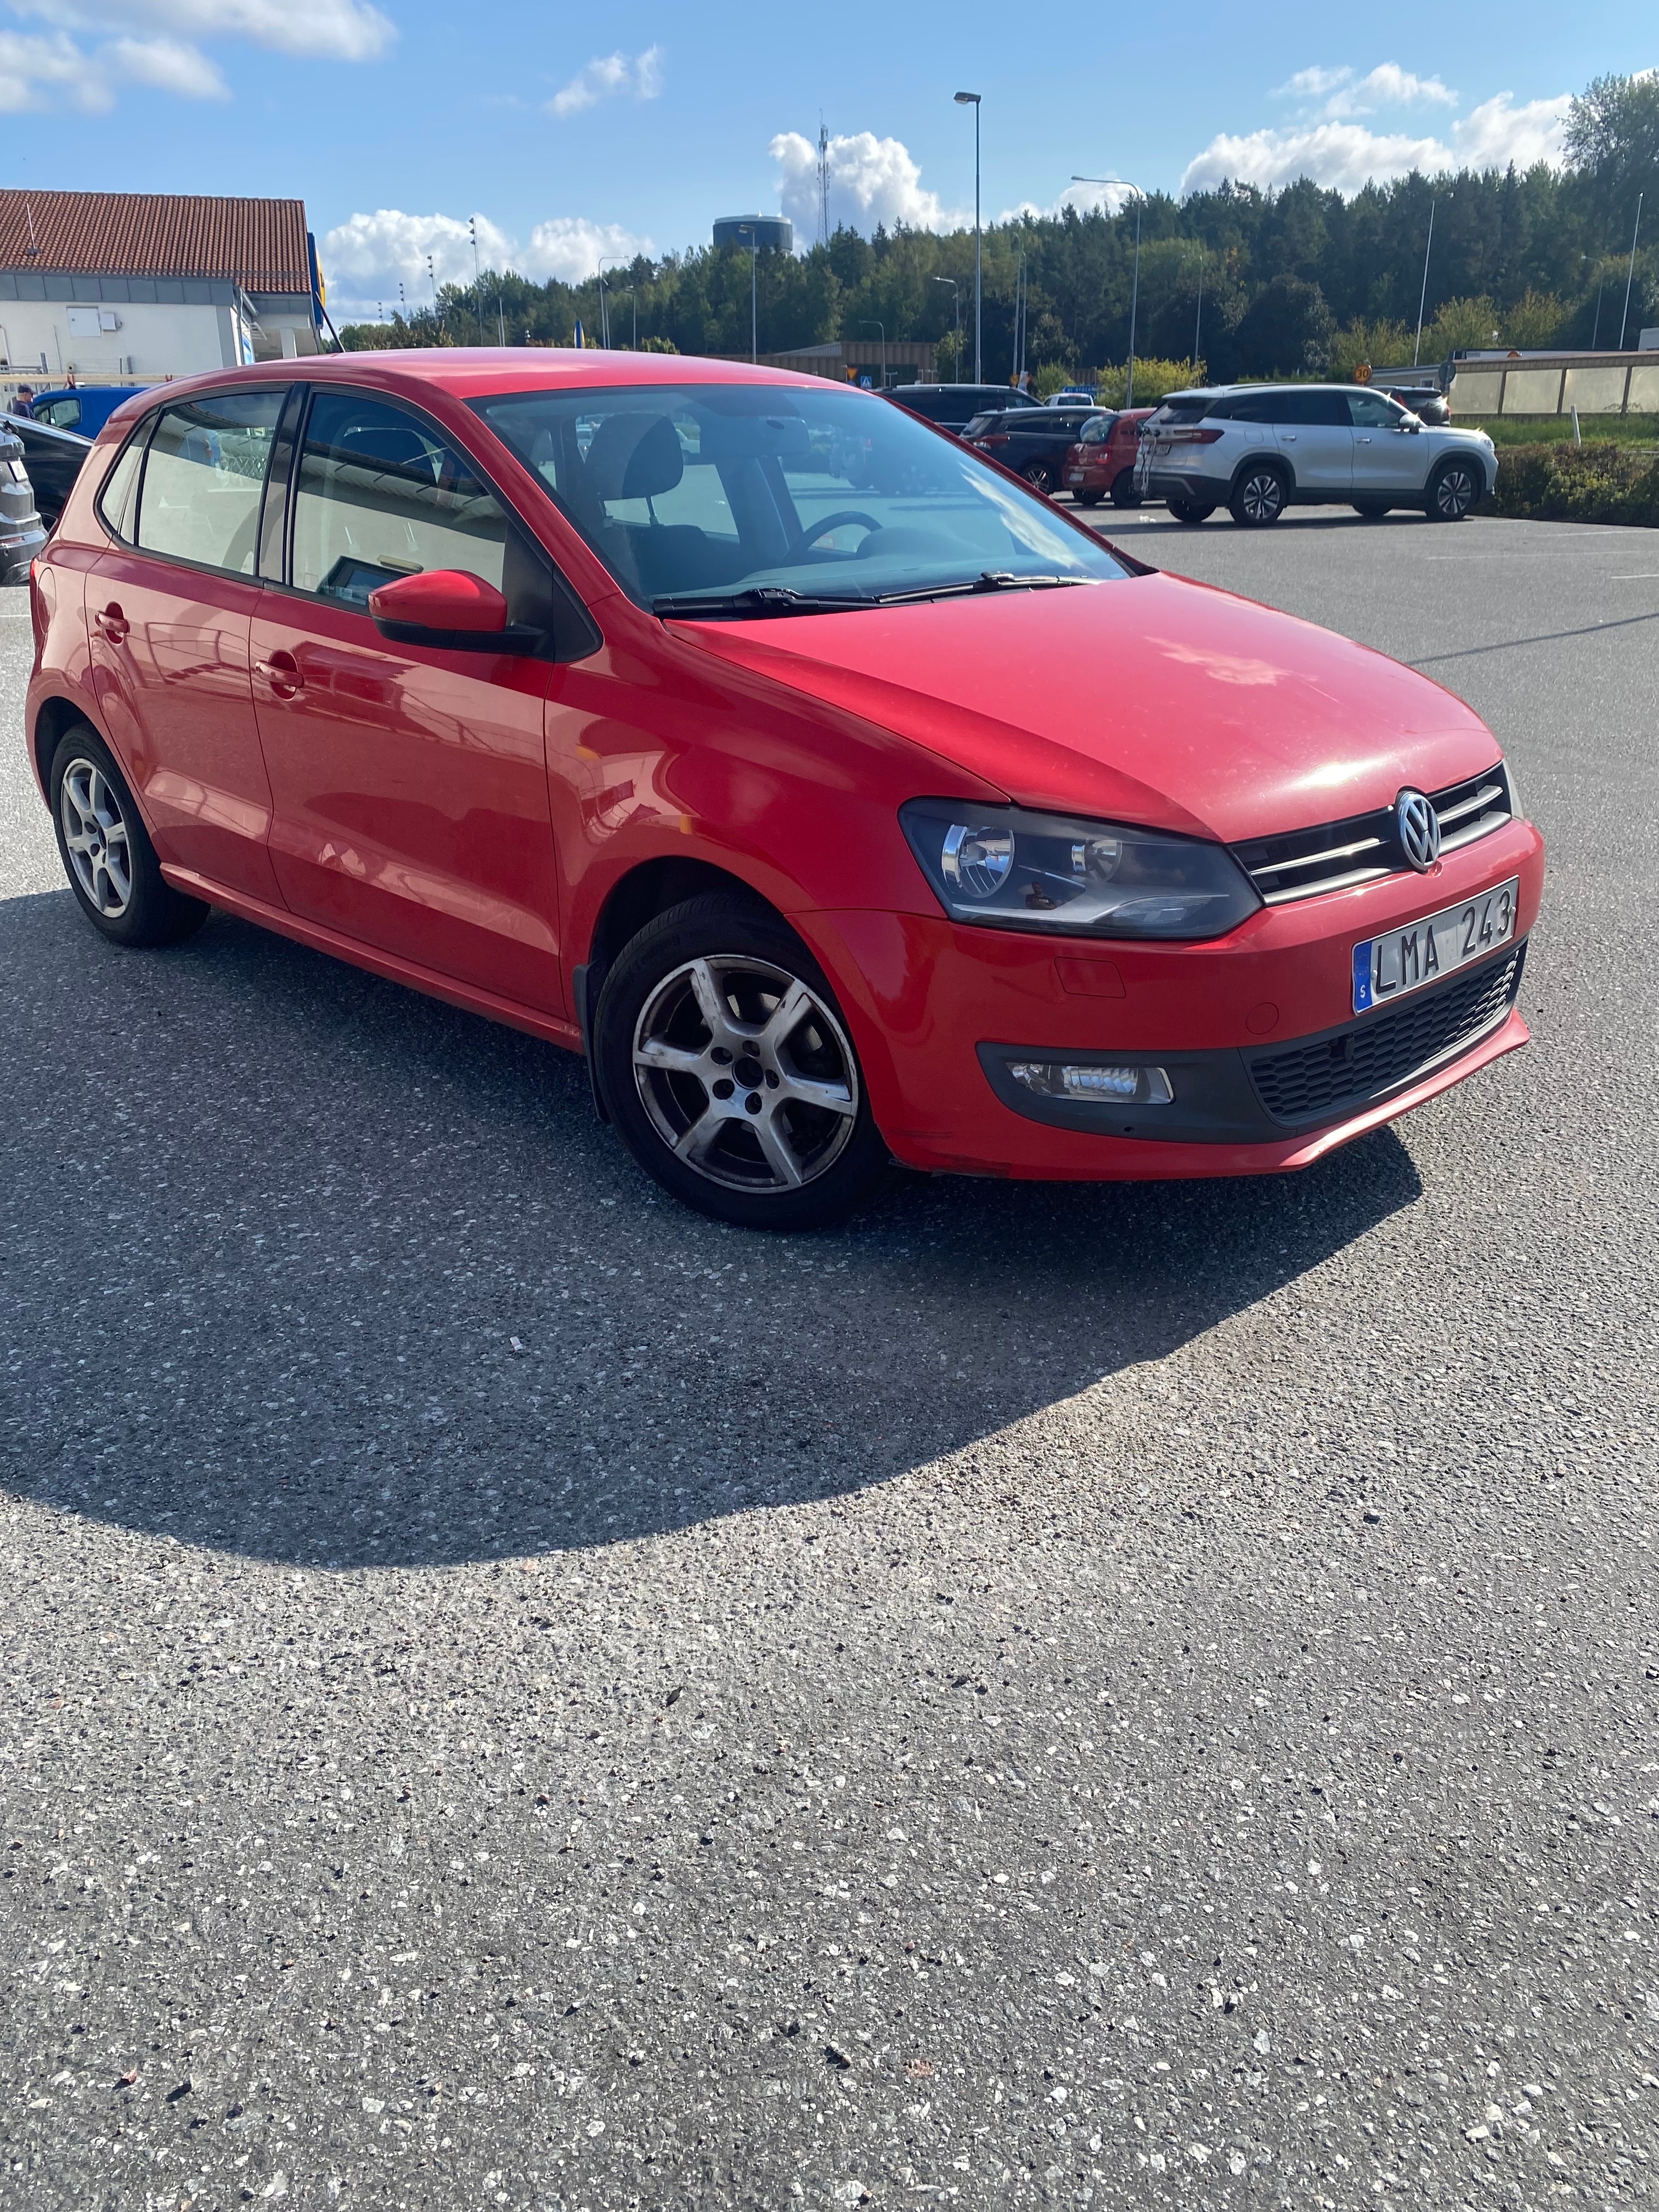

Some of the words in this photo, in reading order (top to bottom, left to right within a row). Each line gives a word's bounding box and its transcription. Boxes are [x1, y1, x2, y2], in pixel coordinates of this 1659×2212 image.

[1357, 369, 1369, 378] 30
[1375, 924, 1440, 994] LMA
[1462, 889, 1510, 957] 243
[1360, 984, 1366, 998] S
